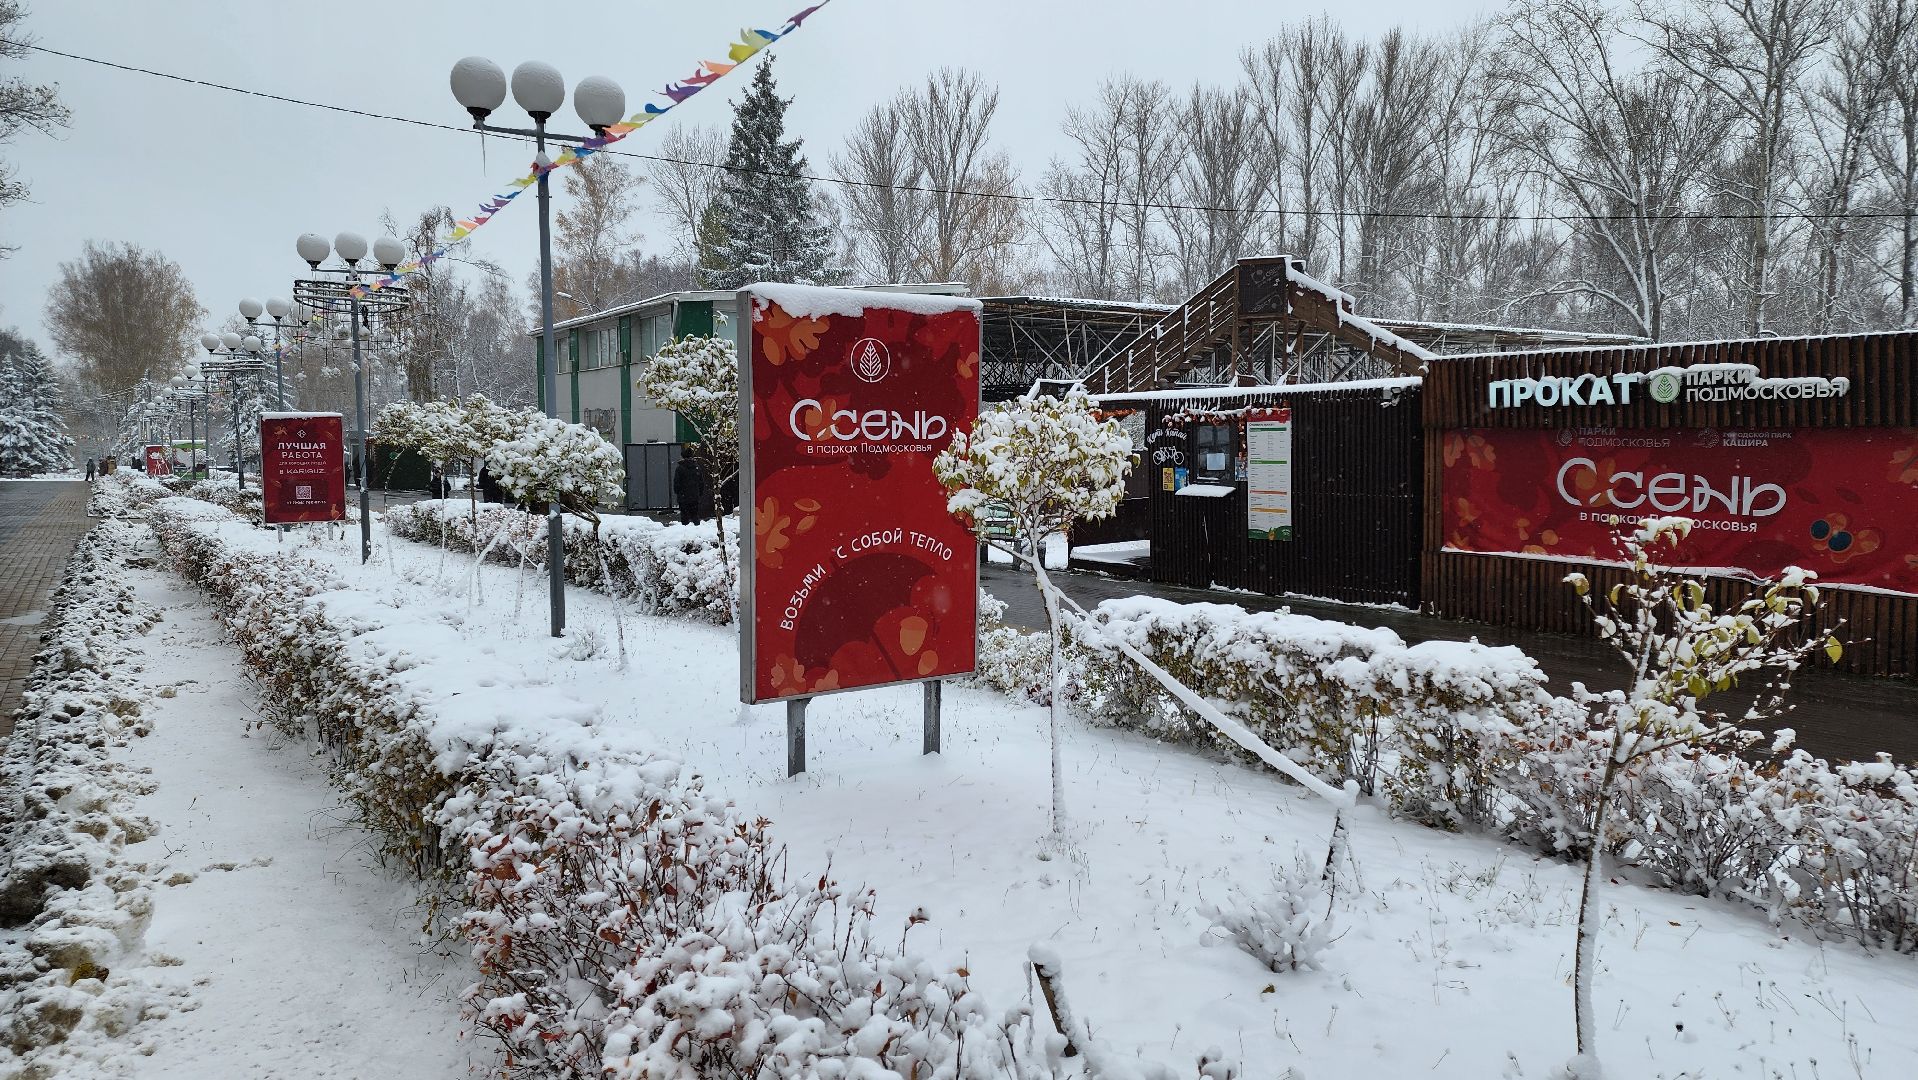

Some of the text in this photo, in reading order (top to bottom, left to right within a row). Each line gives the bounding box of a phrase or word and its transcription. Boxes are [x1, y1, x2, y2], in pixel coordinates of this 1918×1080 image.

[1686, 369, 1751, 386] ПАРКИ
[1489, 374, 1638, 409] ПРОКАТ
[1686, 381, 1845, 402] ПОДМОСКОВЬЯ
[789, 398, 947, 441] Осень
[1579, 427, 1616, 436] ПАРКИ
[277, 442, 327, 450] ЛУЧШАЯ
[807, 442, 932, 456] в парках Подмосковья
[1578, 437, 1671, 448] ПОДМОСКОВЬЯ
[1723, 439, 1769, 447] КАШИРА
[1556, 457, 1787, 517] Осень
[1580, 512, 1588, 521] в
[1649, 513, 1758, 533] Посковья
[780, 528, 953, 631] ВОЗЬМИ С СОБОЙ ТЕПЛО
